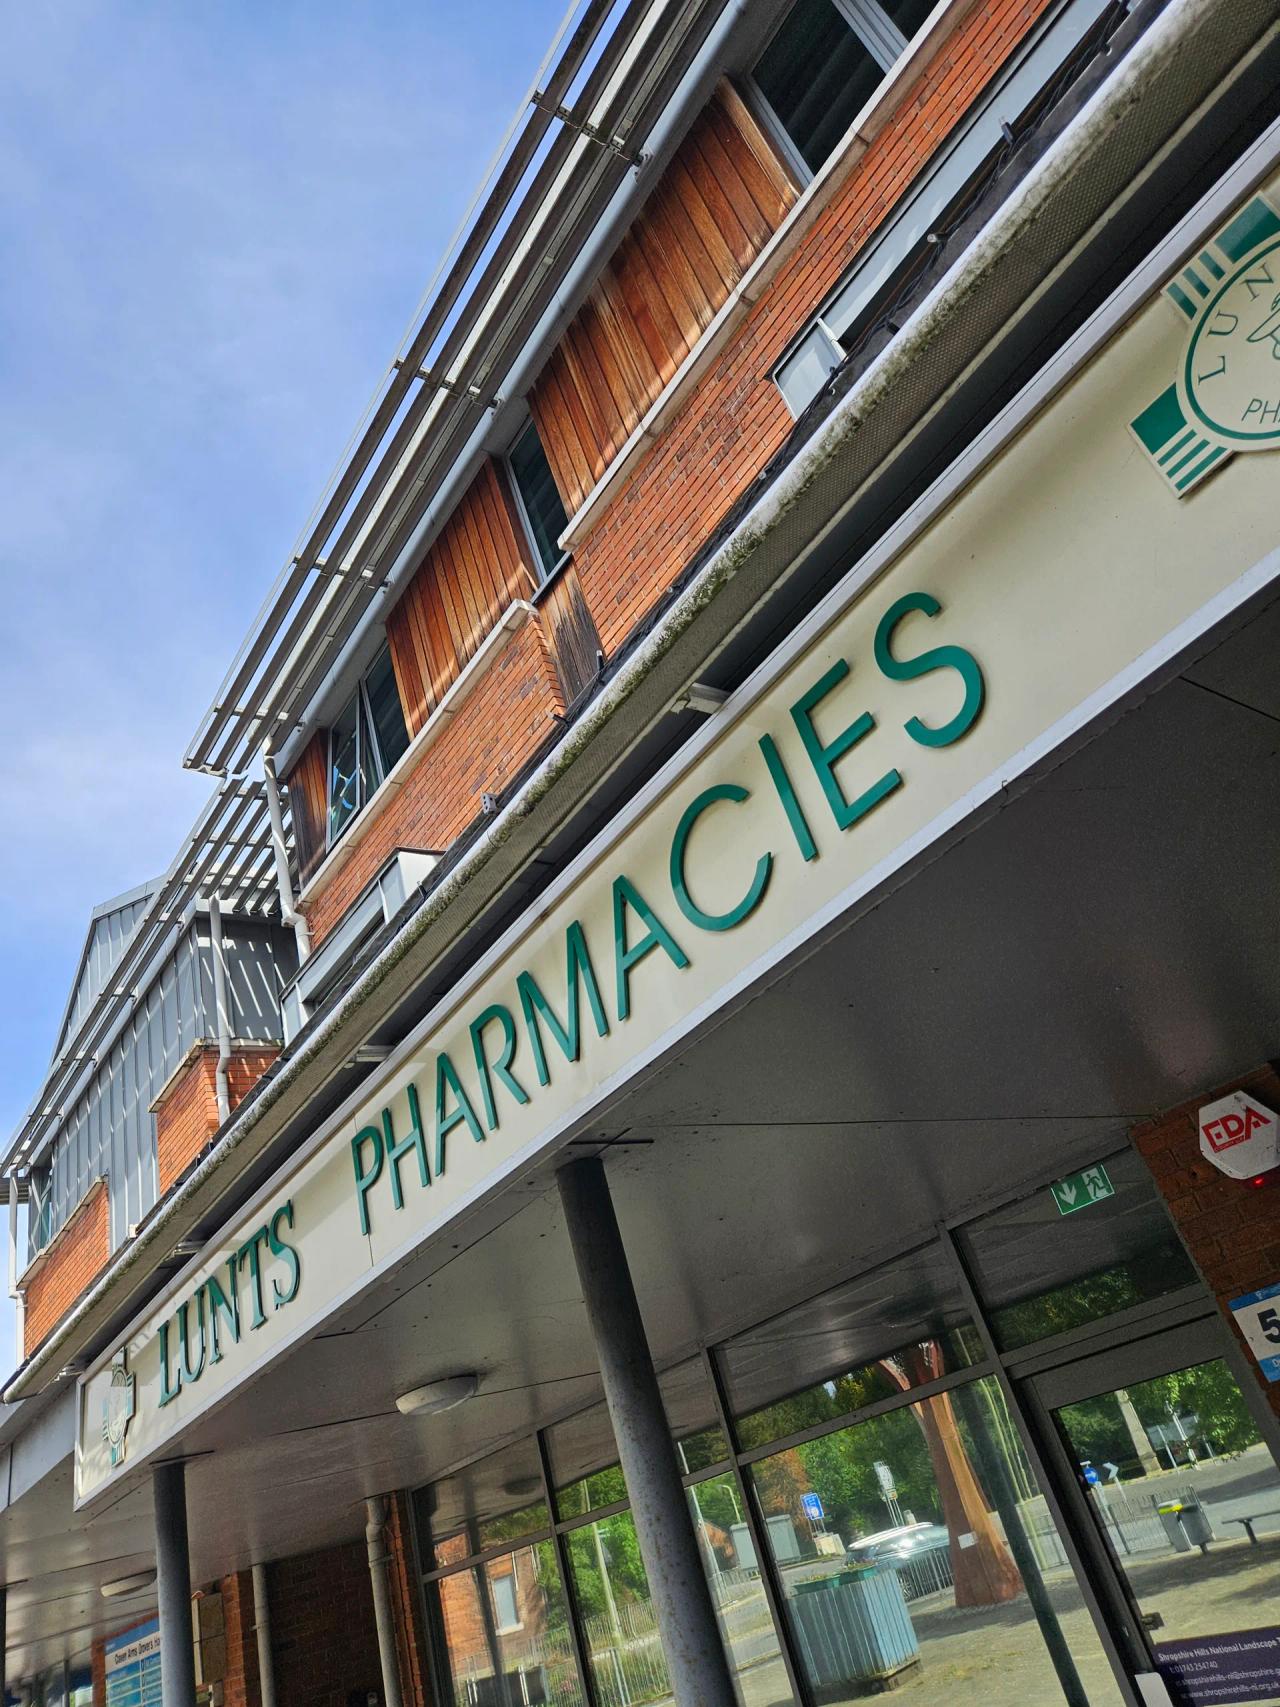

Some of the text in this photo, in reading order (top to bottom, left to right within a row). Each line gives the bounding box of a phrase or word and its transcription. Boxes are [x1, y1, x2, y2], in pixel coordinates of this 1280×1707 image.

[1241, 398, 1280, 424] PH
[157, 591, 986, 1408] LUNTS PHARMACIES
[1201, 1105, 1271, 1153] EDA
[1158, 1651, 1194, 1661] Shropshire
[1194, 1648, 1209, 1657] Hills
[1209, 1644, 1240, 1654] National
[1240, 1639, 1277, 1650] Landscape
[1175, 1663, 1195, 1673] 01743
